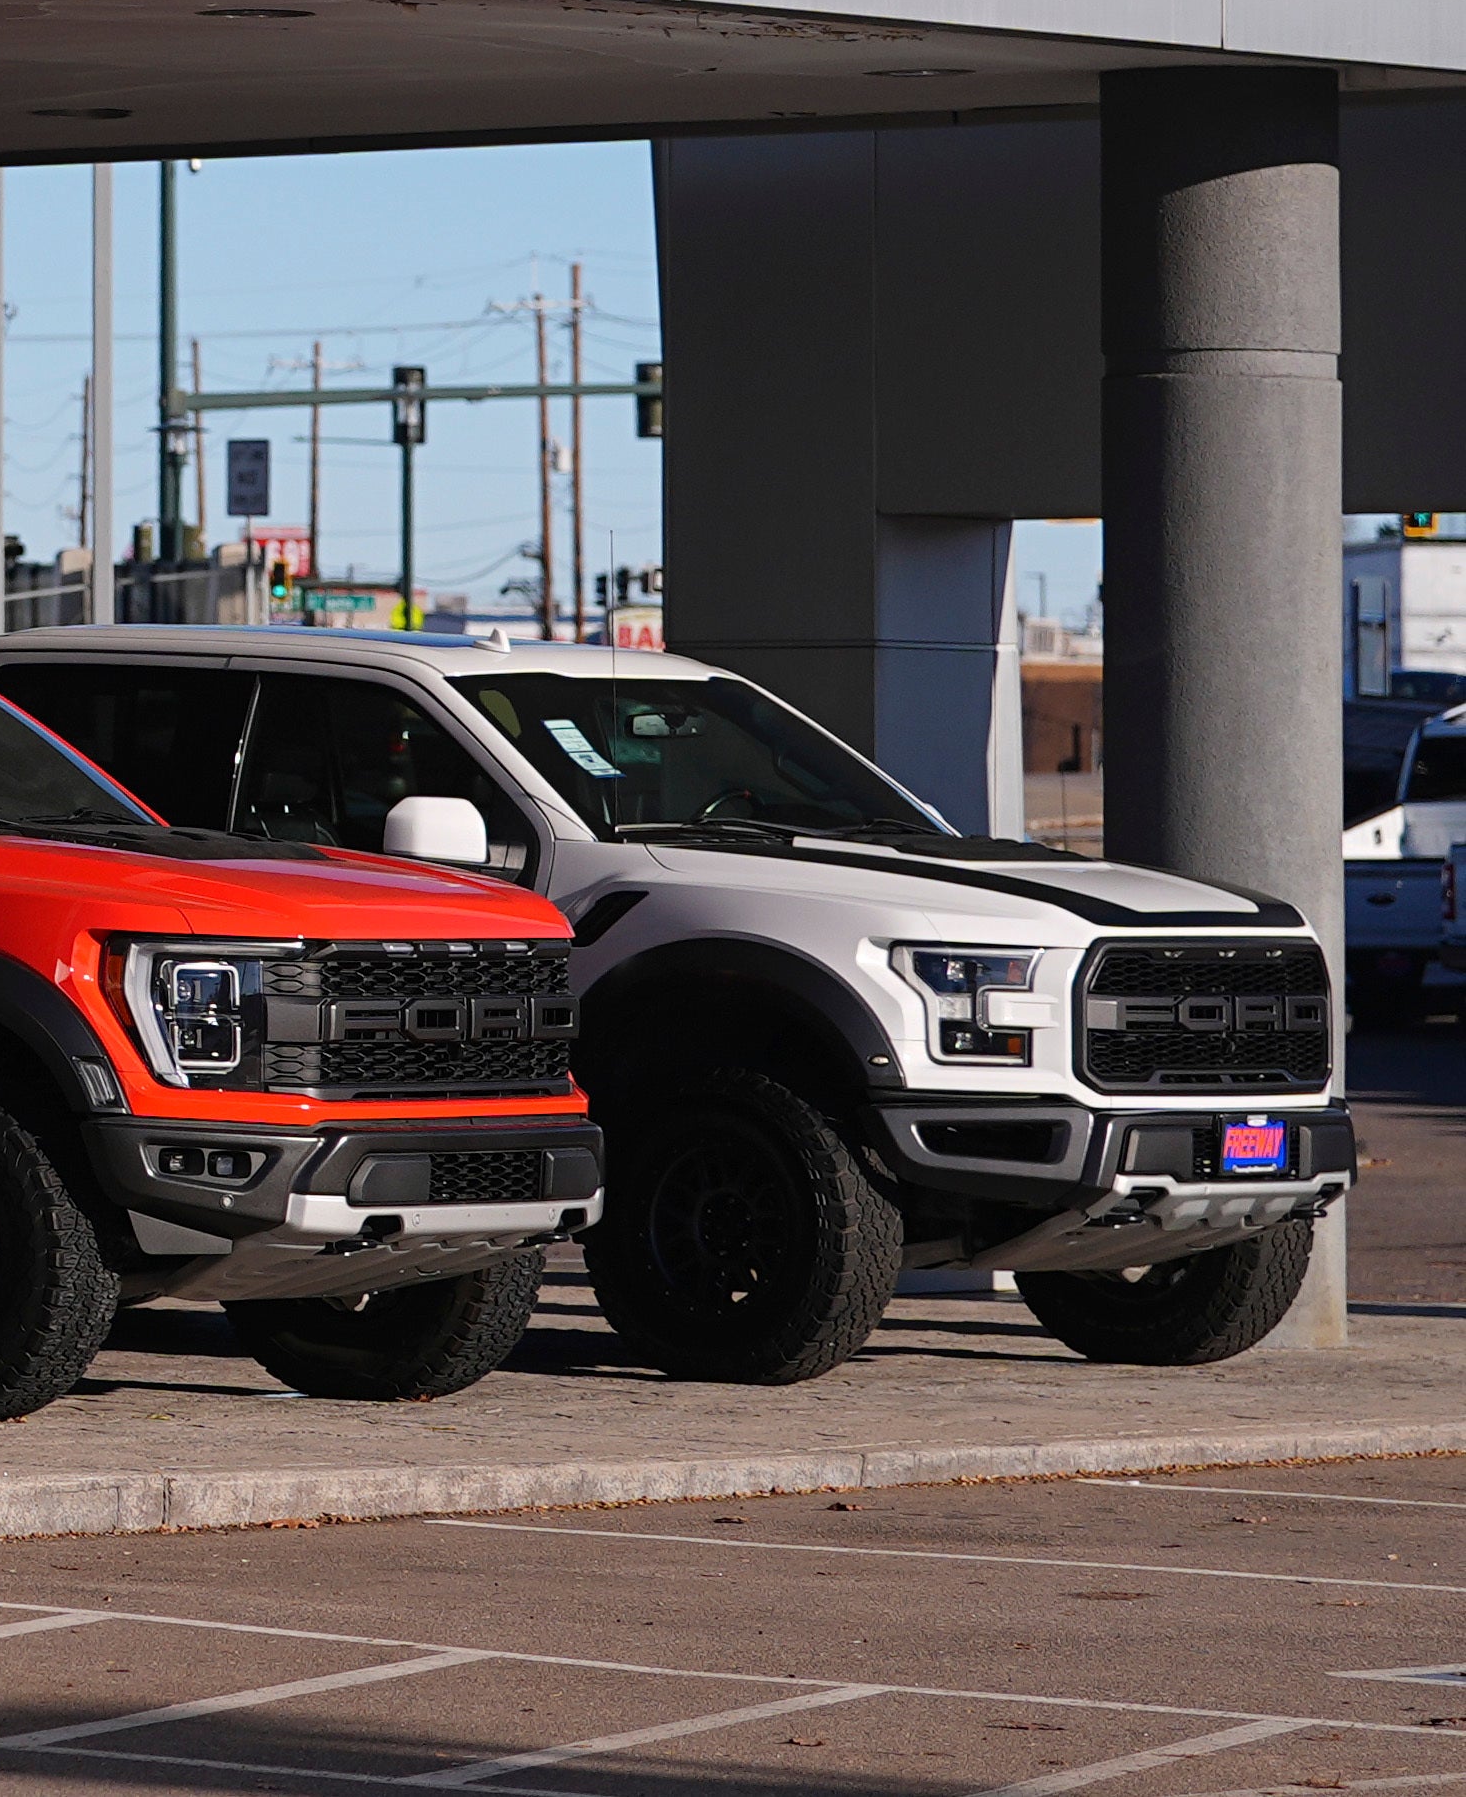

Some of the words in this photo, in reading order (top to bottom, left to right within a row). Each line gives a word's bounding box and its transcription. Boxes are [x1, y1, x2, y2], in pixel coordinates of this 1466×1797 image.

[328, 996, 580, 1042] FORD
[1117, 995, 1328, 1031] FORD
[1223, 1127, 1284, 1158] FREEWAY
